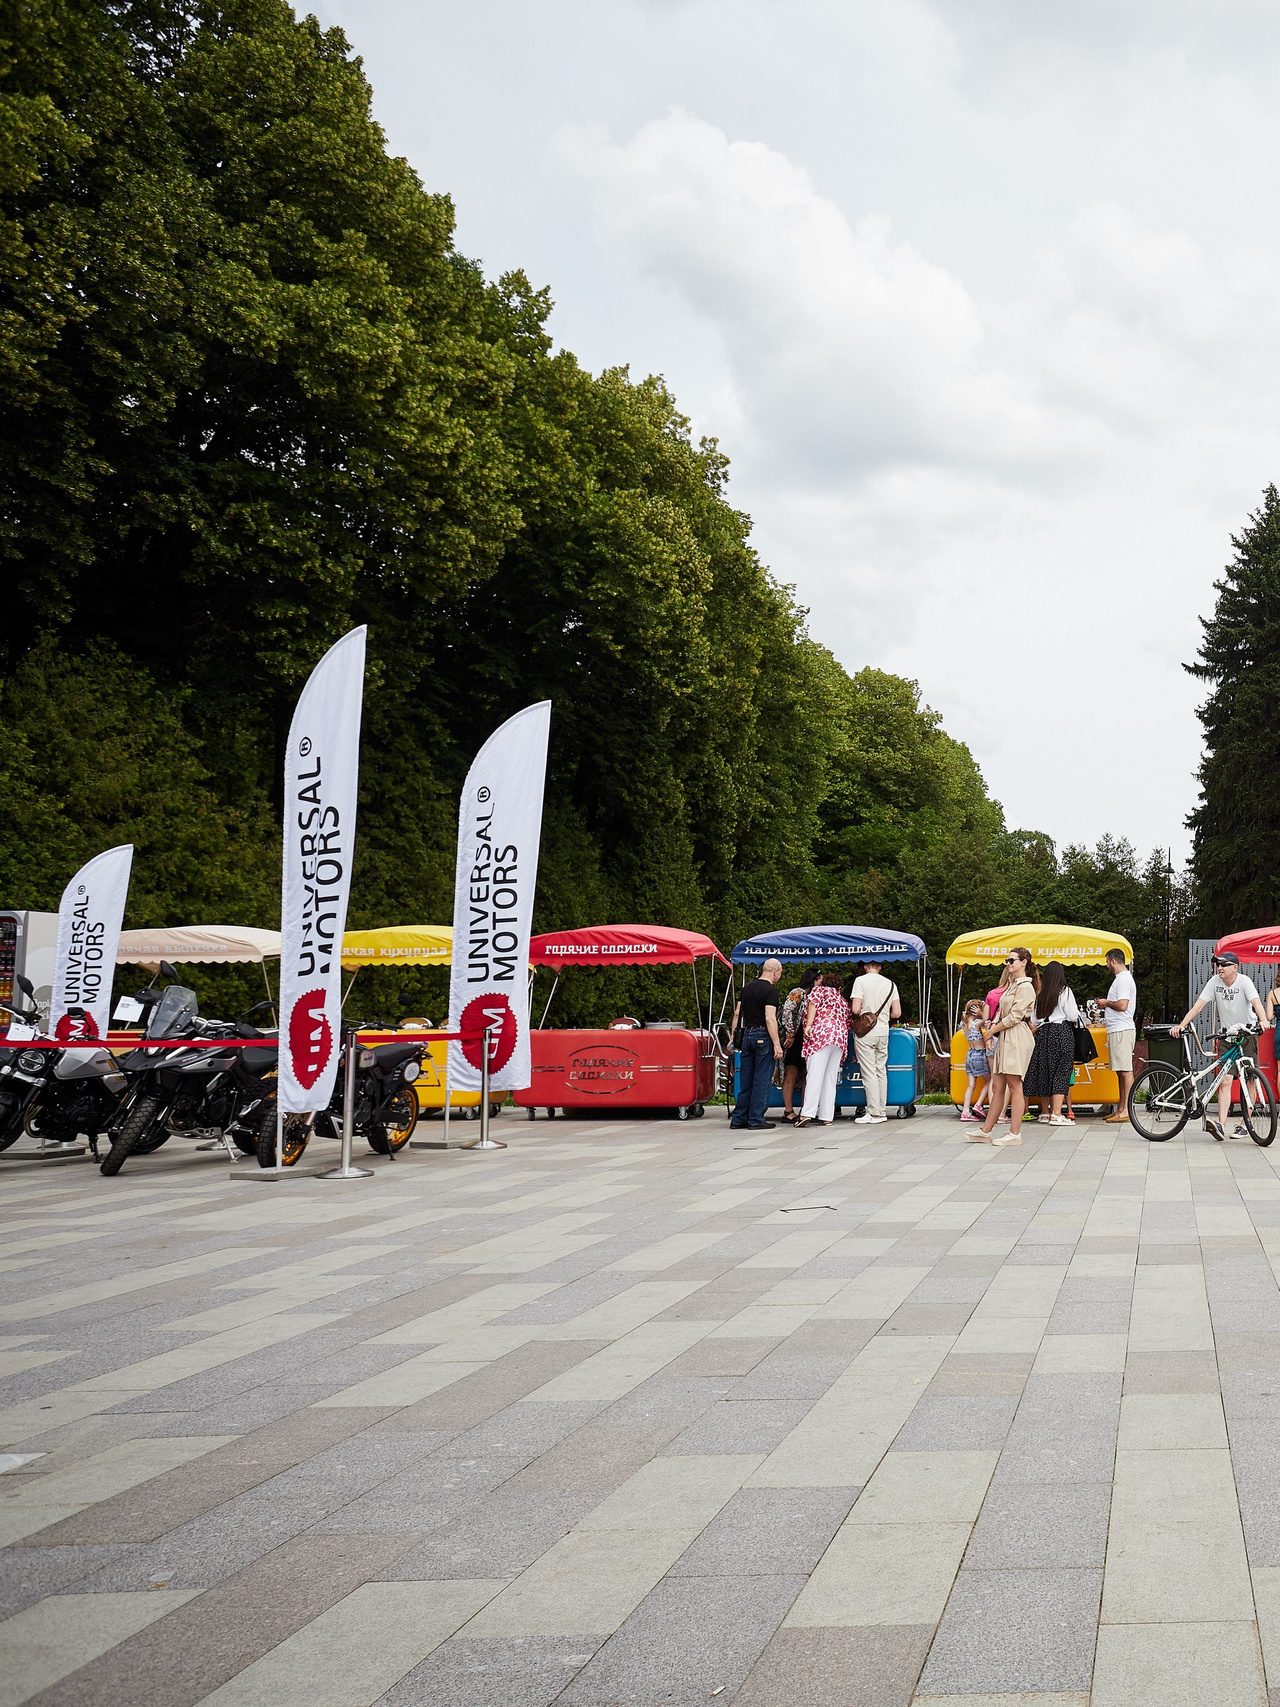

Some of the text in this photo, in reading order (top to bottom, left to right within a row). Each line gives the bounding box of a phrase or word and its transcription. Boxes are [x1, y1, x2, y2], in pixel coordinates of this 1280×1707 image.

[493, 844, 518, 981] MOTORS
[82, 921, 105, 1004] MOTORS
[341, 947, 447, 958] ячая кукуруза
[1037, 946, 1103, 957] кукуруза
